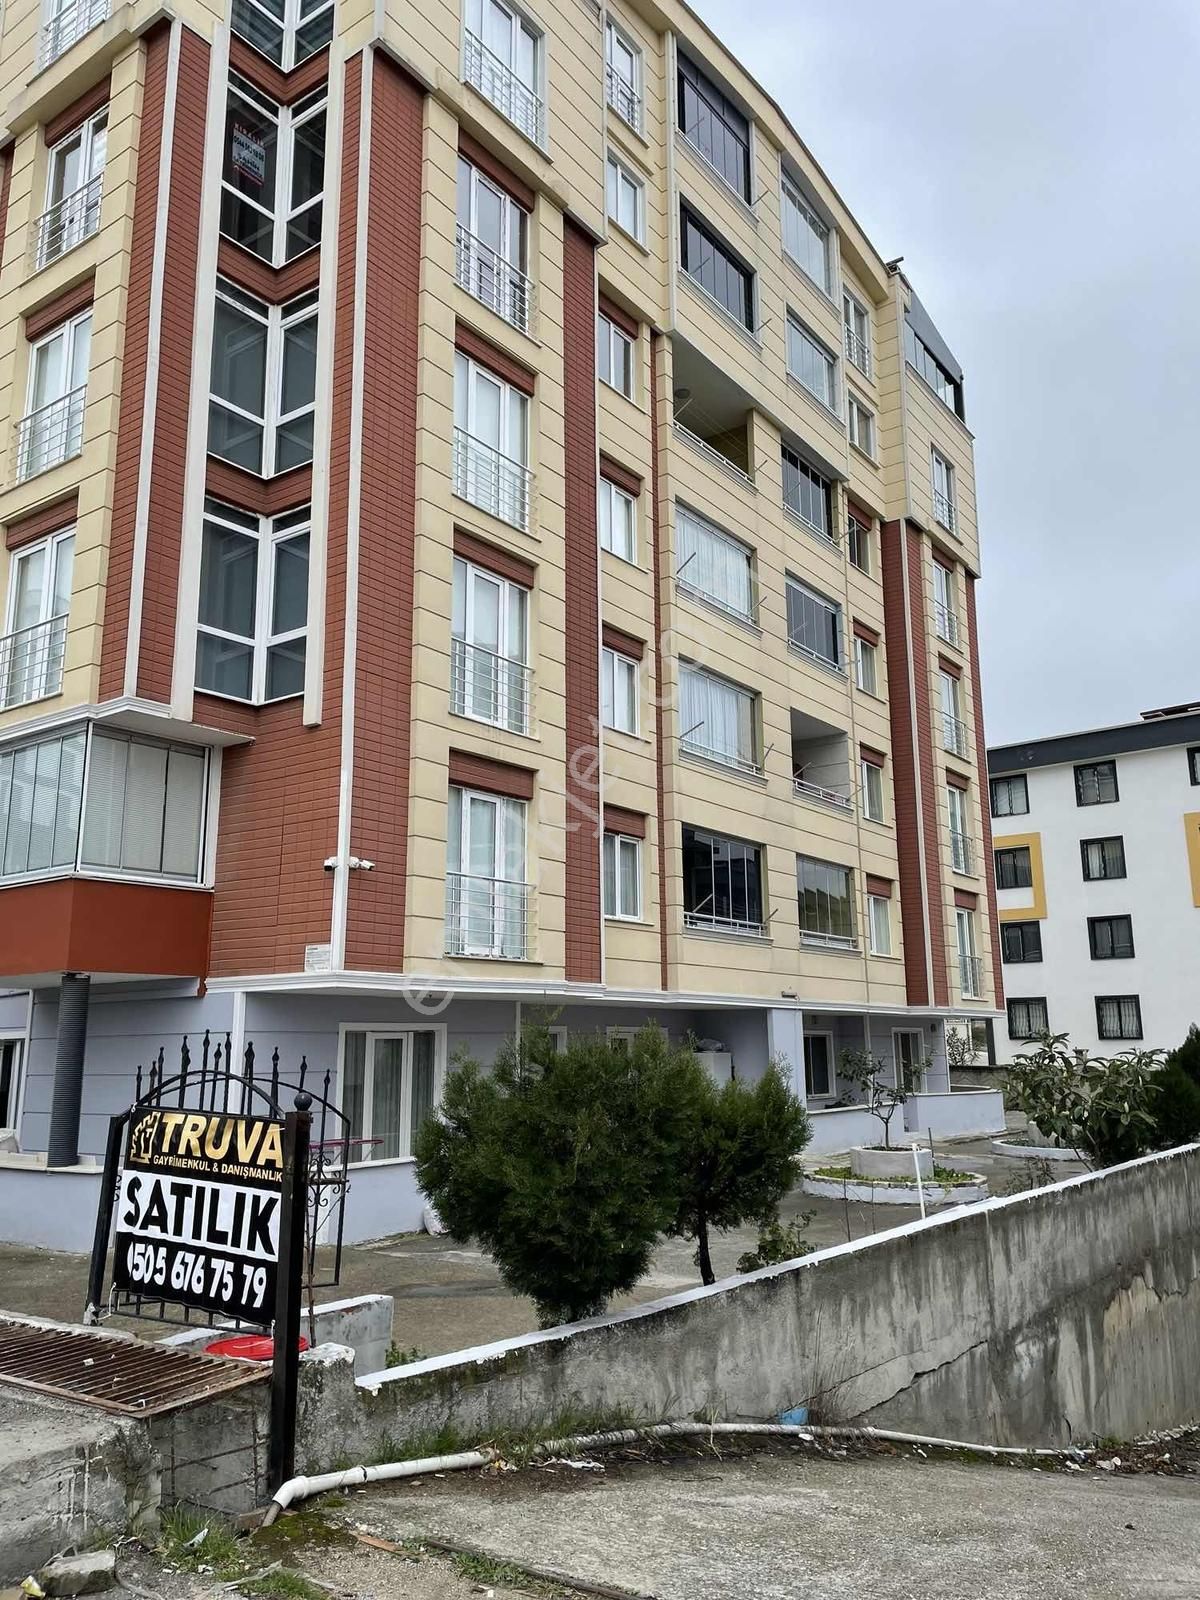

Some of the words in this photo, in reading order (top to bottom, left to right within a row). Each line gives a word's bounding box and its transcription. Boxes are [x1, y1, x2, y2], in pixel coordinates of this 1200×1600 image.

[162, 1112, 284, 1169] TRUVA
[212, 1162, 219, 1173] &
[123, 1175, 279, 1256] SATILIK
[171, 1250, 206, 1294] 676
[209, 1257, 235, 1302] 75
[241, 1263, 267, 1308] 79
